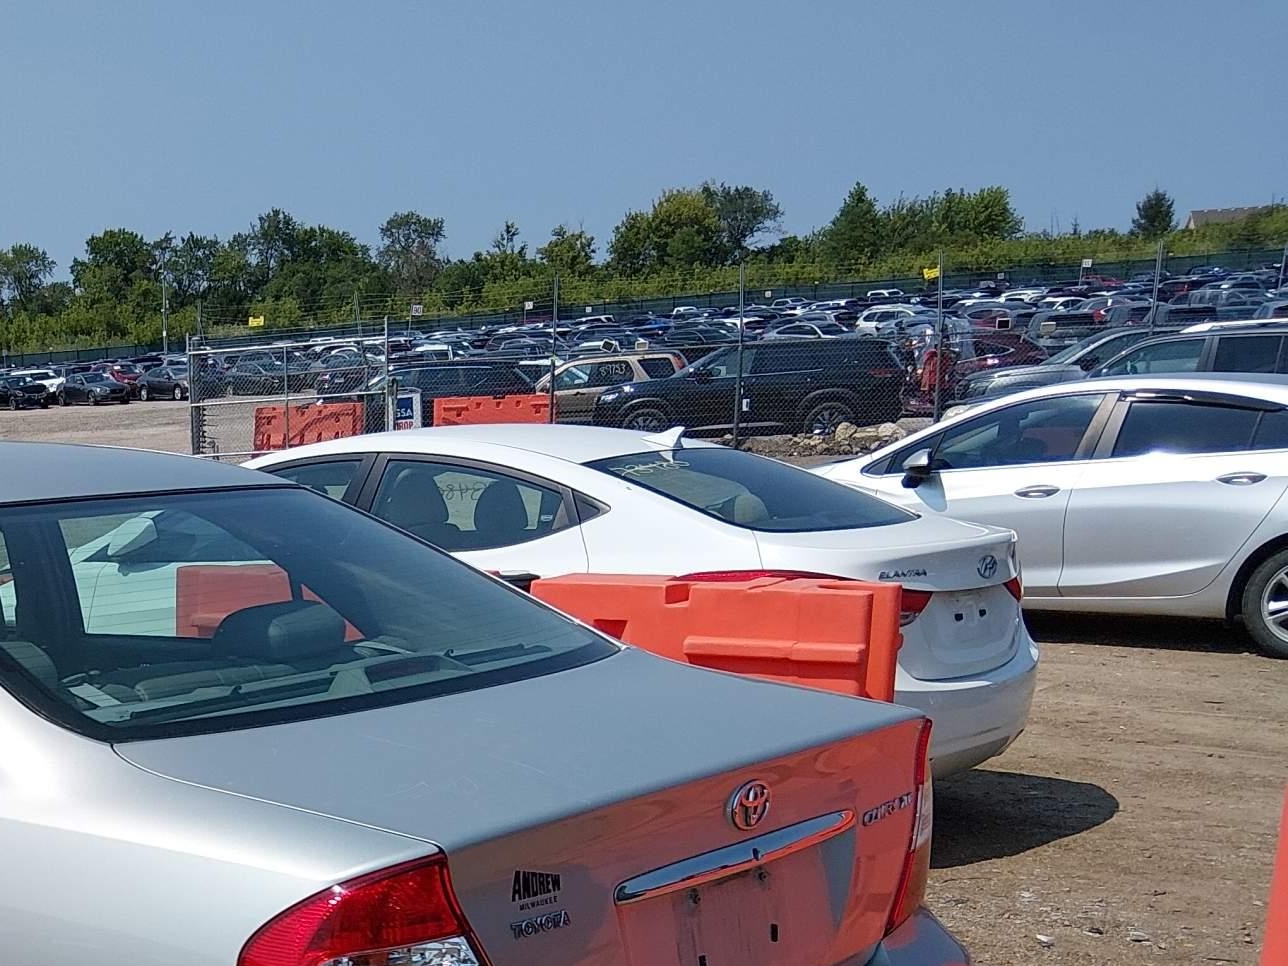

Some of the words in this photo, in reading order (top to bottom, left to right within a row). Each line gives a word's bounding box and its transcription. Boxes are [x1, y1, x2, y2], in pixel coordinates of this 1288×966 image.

[879, 568, 928, 580] ELANTRA
[512, 870, 561, 902] ANDREW
[519, 895, 558, 911] MILWAUKEE
[510, 909, 571, 939] TOYOTA
